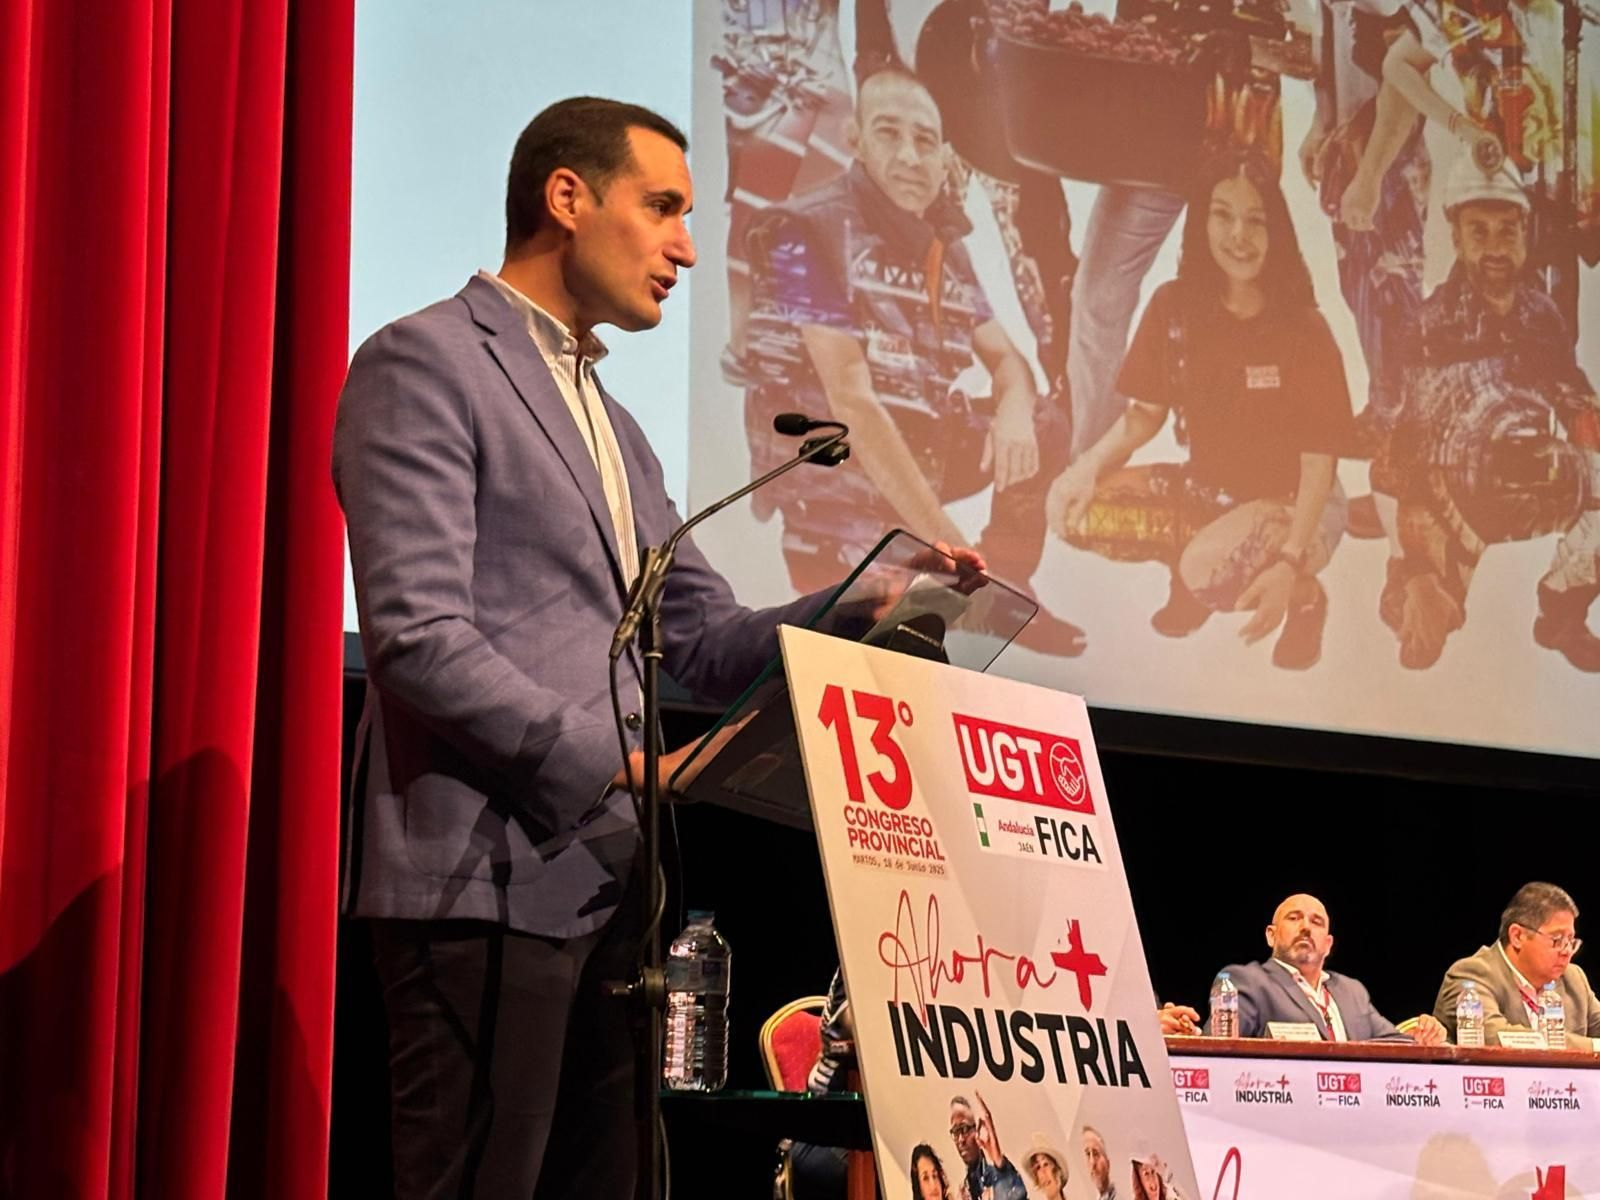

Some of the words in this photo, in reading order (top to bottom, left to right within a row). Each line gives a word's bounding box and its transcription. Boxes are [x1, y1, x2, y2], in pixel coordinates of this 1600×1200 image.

[960, 723, 1046, 796] UGT
[843, 805, 933, 838] CONGRESO
[847, 827, 946, 860] PROVINCIAL
[1034, 815, 1103, 865] FICA
[887, 1000, 1152, 1089] INDUSTRIA
[1318, 1074, 1346, 1090] UGT
[1464, 1078, 1491, 1095] UGT
[1185, 1091, 1209, 1103] FICA
[1235, 1089, 1293, 1104] INDUSTRIA
[1338, 1095, 1361, 1106] FICA
[1386, 1093, 1441, 1107] INDUSTRIA
[1483, 1098, 1505, 1110] FICA
[1528, 1096, 1581, 1110] INDUSTRIA
